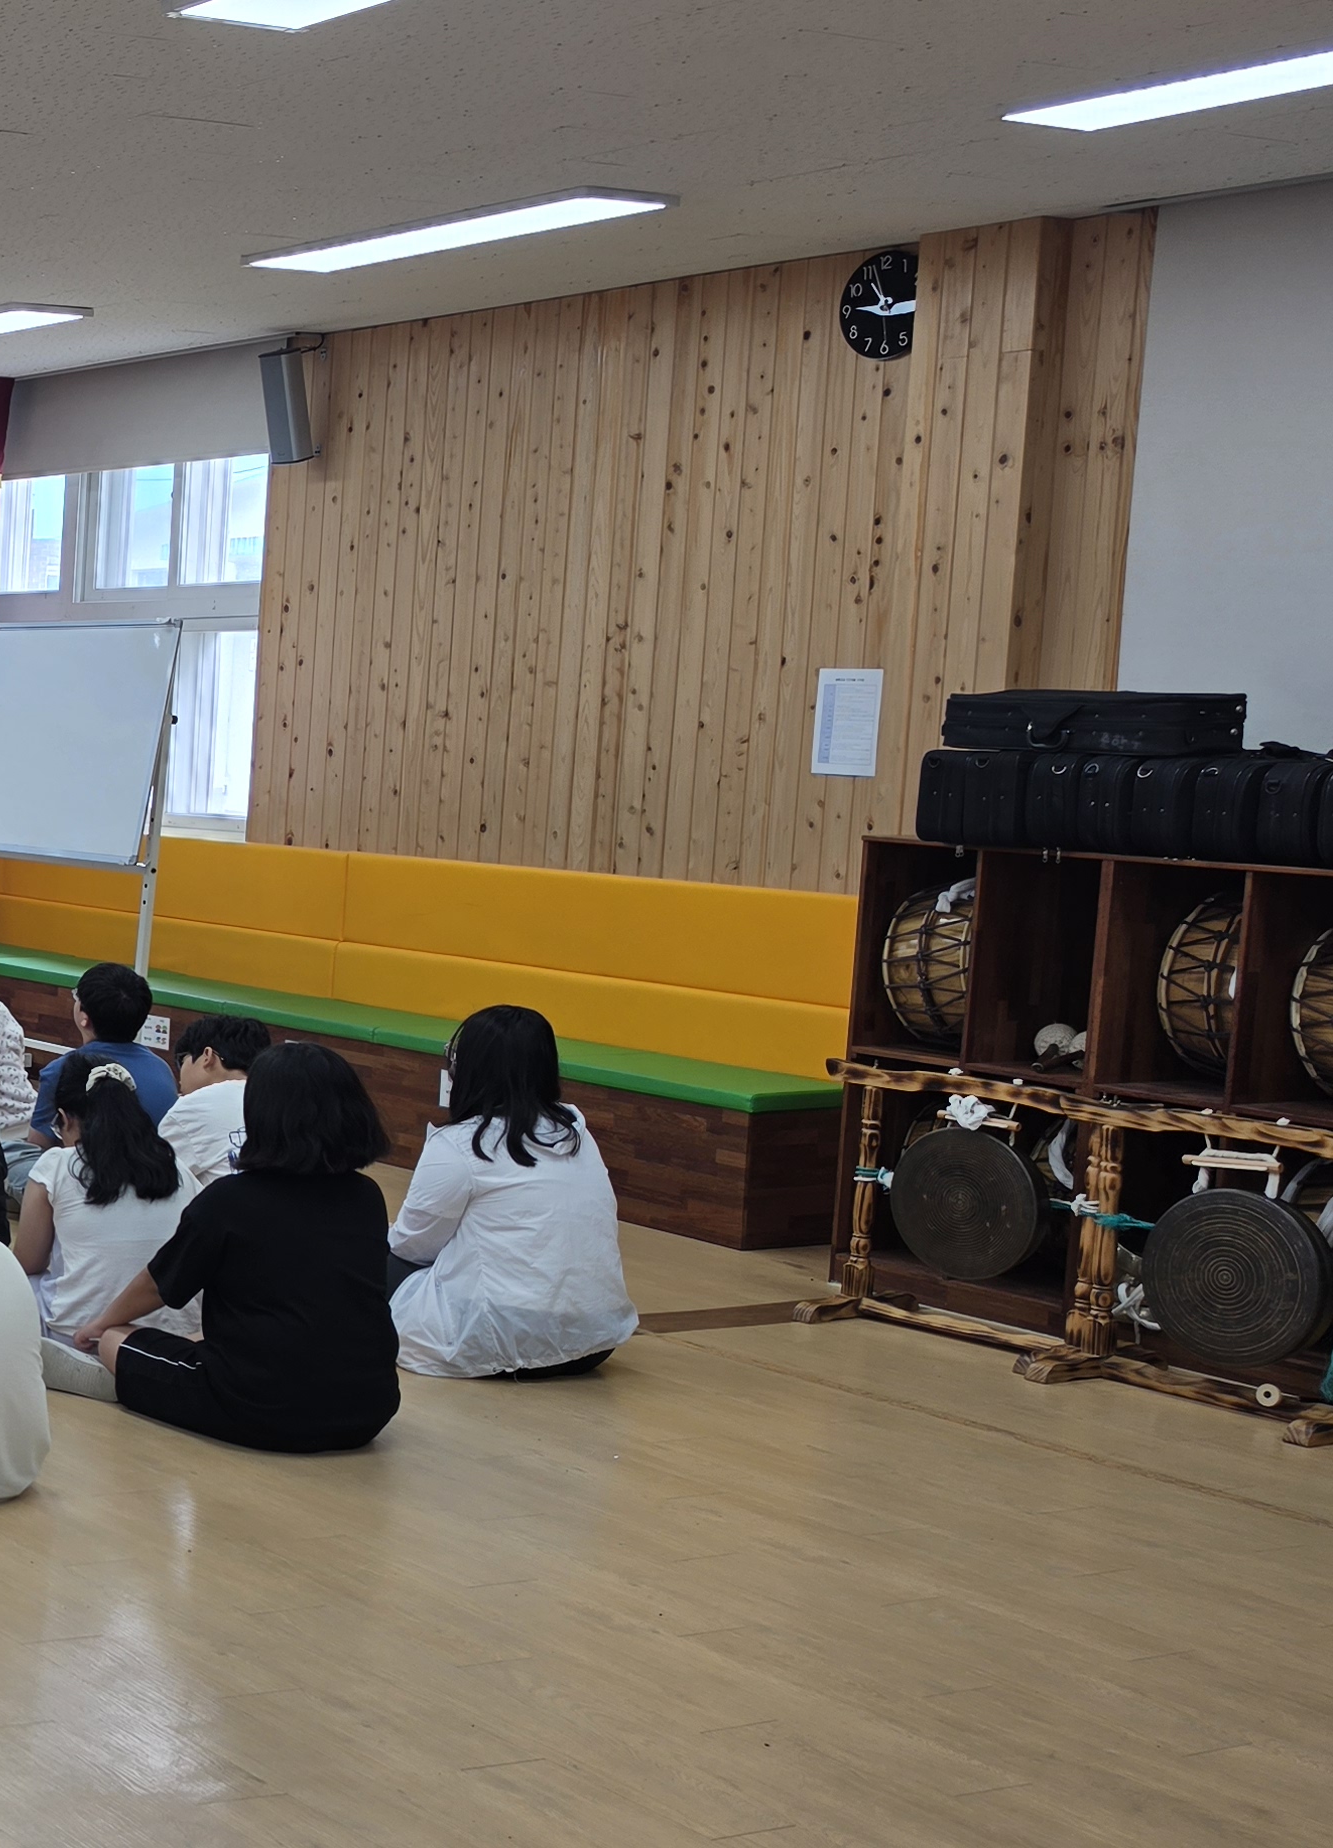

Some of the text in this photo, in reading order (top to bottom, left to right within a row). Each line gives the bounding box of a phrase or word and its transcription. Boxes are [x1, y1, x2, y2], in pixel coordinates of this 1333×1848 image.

[880, 255, 892, 270] 12
[903, 259, 907, 273] 1
[863, 266, 872, 280] 11
[849, 283, 863, 298] 10
[842, 305, 851, 319] 9
[849, 325, 858, 339] 8
[898, 331, 908, 346] 5
[864, 337, 872, 352] 7
[880, 340, 889, 355] 6
